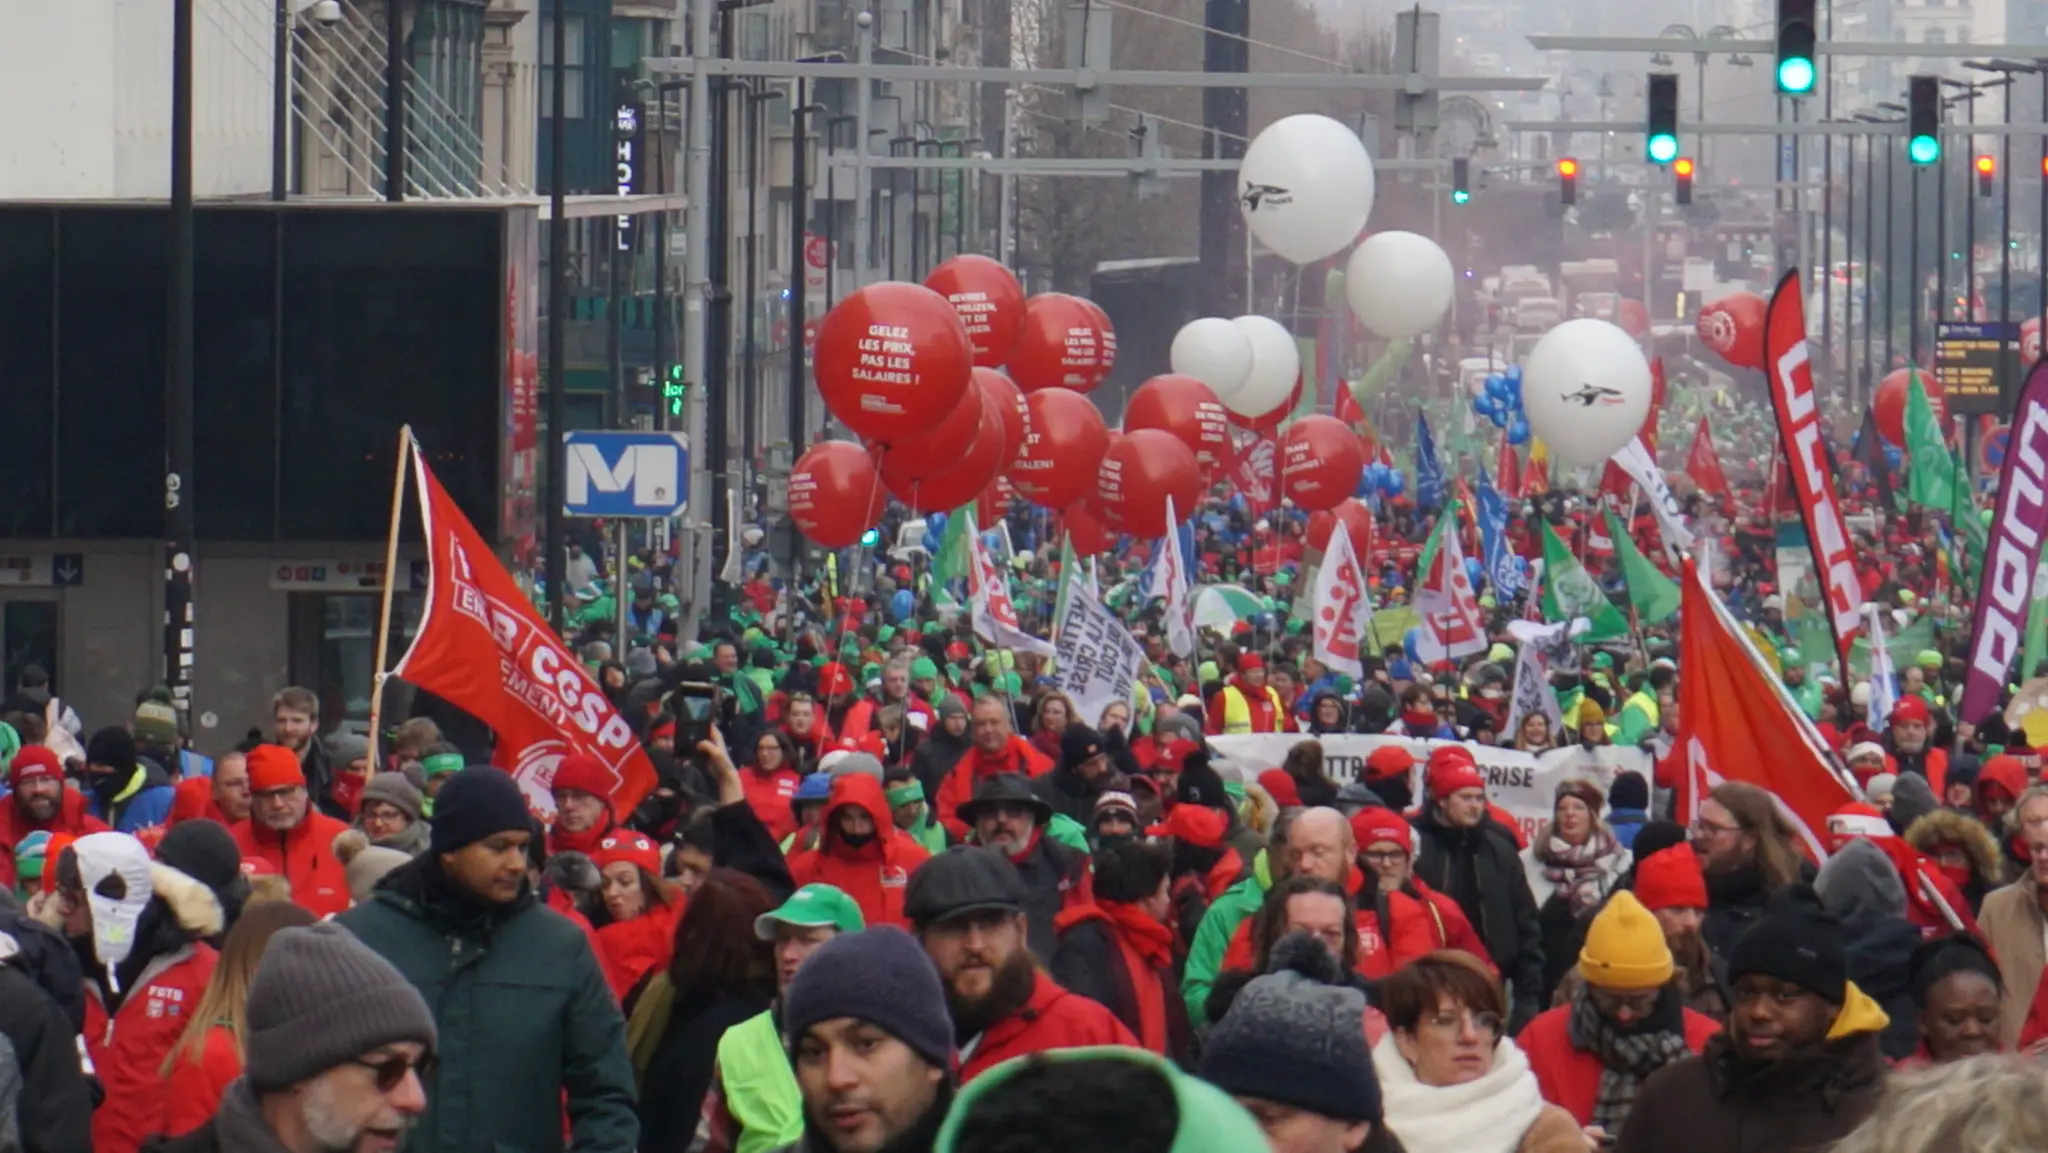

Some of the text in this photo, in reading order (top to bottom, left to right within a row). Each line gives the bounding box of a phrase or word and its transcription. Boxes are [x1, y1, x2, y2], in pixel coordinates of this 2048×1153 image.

[869, 325, 908, 338] GELEZ
[859, 338, 915, 356] LES PRIX,
[861, 353, 910, 370] PAS LES
[852, 367, 911, 384] SALAIRES
[531, 645, 633, 749] CGSP
